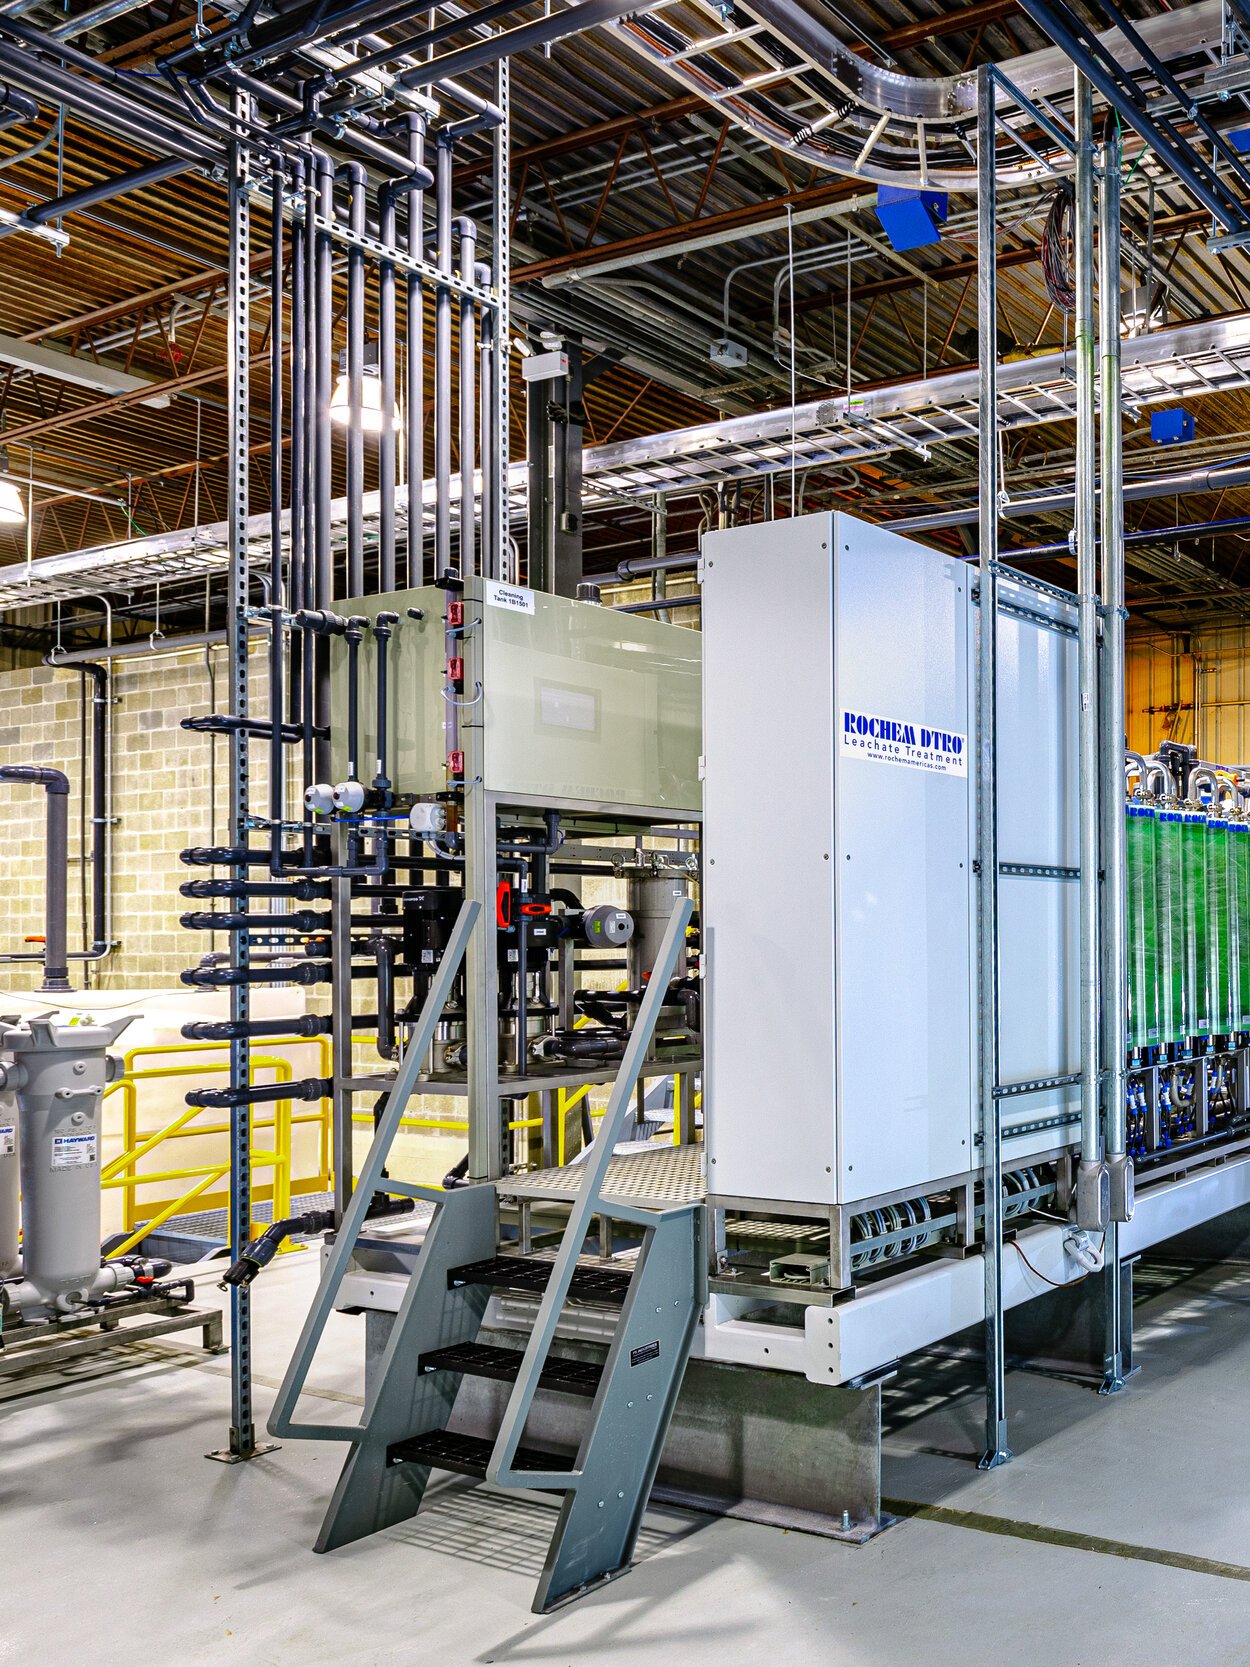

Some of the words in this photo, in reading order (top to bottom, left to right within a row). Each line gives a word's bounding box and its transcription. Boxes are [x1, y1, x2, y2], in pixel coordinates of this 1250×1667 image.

[499, 590, 524, 601] Cleaning
[844, 711, 916, 746] ROCHEM
[844, 734, 900, 754] Leachate
[905, 746, 963, 767] Treatment
[867, 752, 947, 771] www.rochemamericas.com
[63, 1135, 96, 1144] HAYWARD
